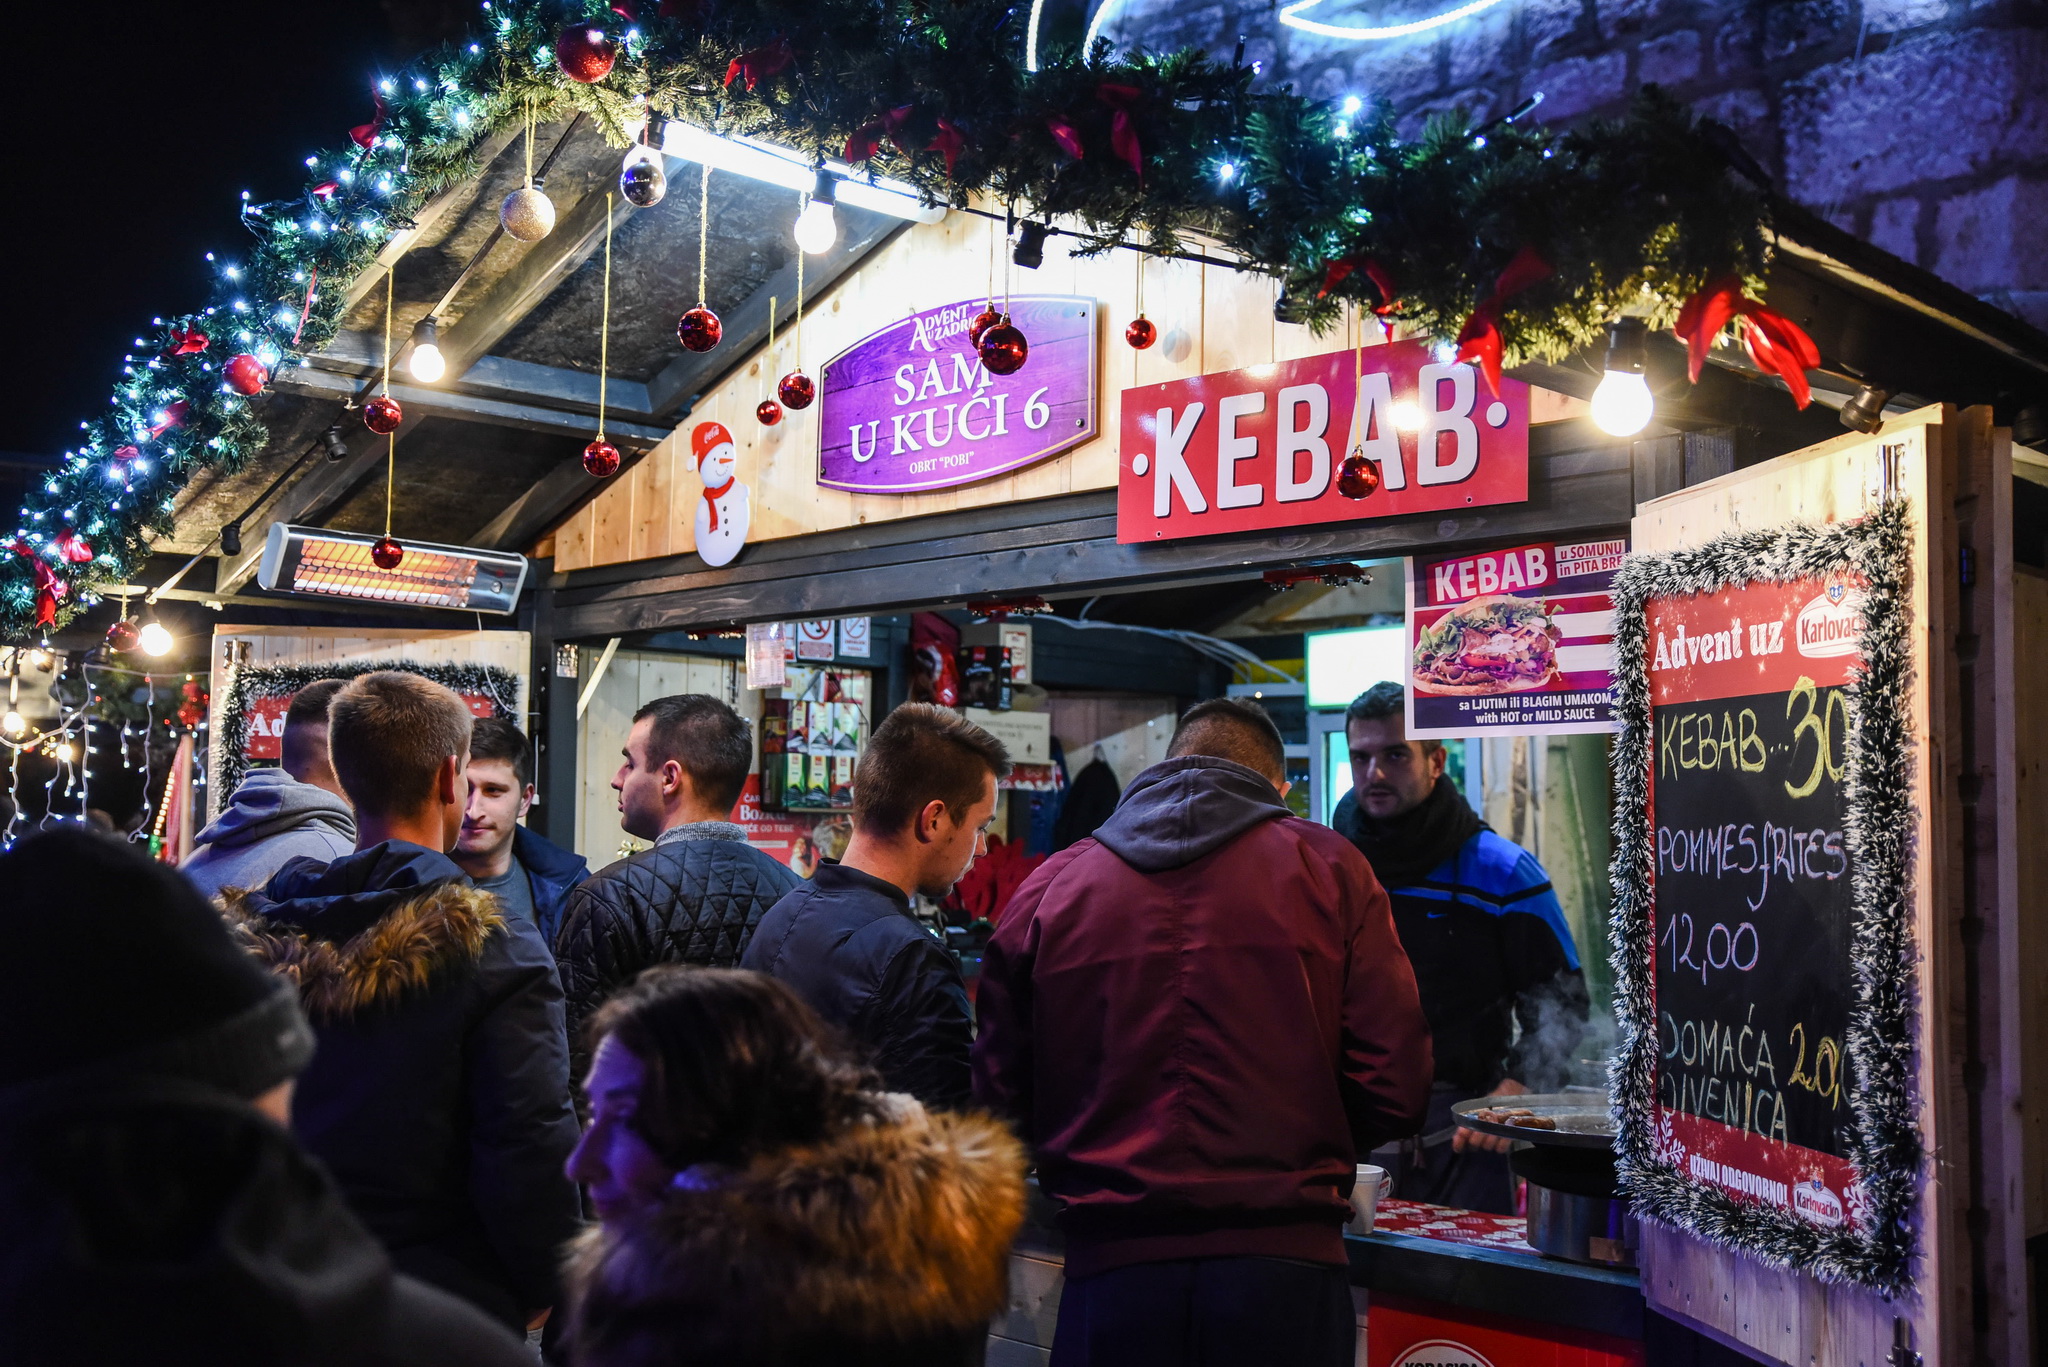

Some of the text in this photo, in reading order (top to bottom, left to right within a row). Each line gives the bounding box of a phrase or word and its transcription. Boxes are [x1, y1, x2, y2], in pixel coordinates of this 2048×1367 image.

[893, 352, 994, 407] SAM
[849, 386, 1051, 463] U KUĆI 6
[1153, 363, 1479, 518] KEBAB
[909, 459, 937, 475] OBRT
[1434, 547, 1549, 603] KEBAB
[1559, 555, 1624, 577] in PITA BRE
[1560, 541, 1623, 560] u SOMUNU
[1651, 617, 1784, 672] Advent uz
[246, 710, 289, 738] Ad
[1458, 692, 1612, 711] sa LJUTIM ili BLAGIM UMAKOM
[1475, 707, 1596, 724] with HOT or MILD SAUCE
[1657, 823, 1758, 880] POMMES
[1660, 912, 1760, 986] 12,00
[1660, 1002, 1778, 1089] DOMAĆA
